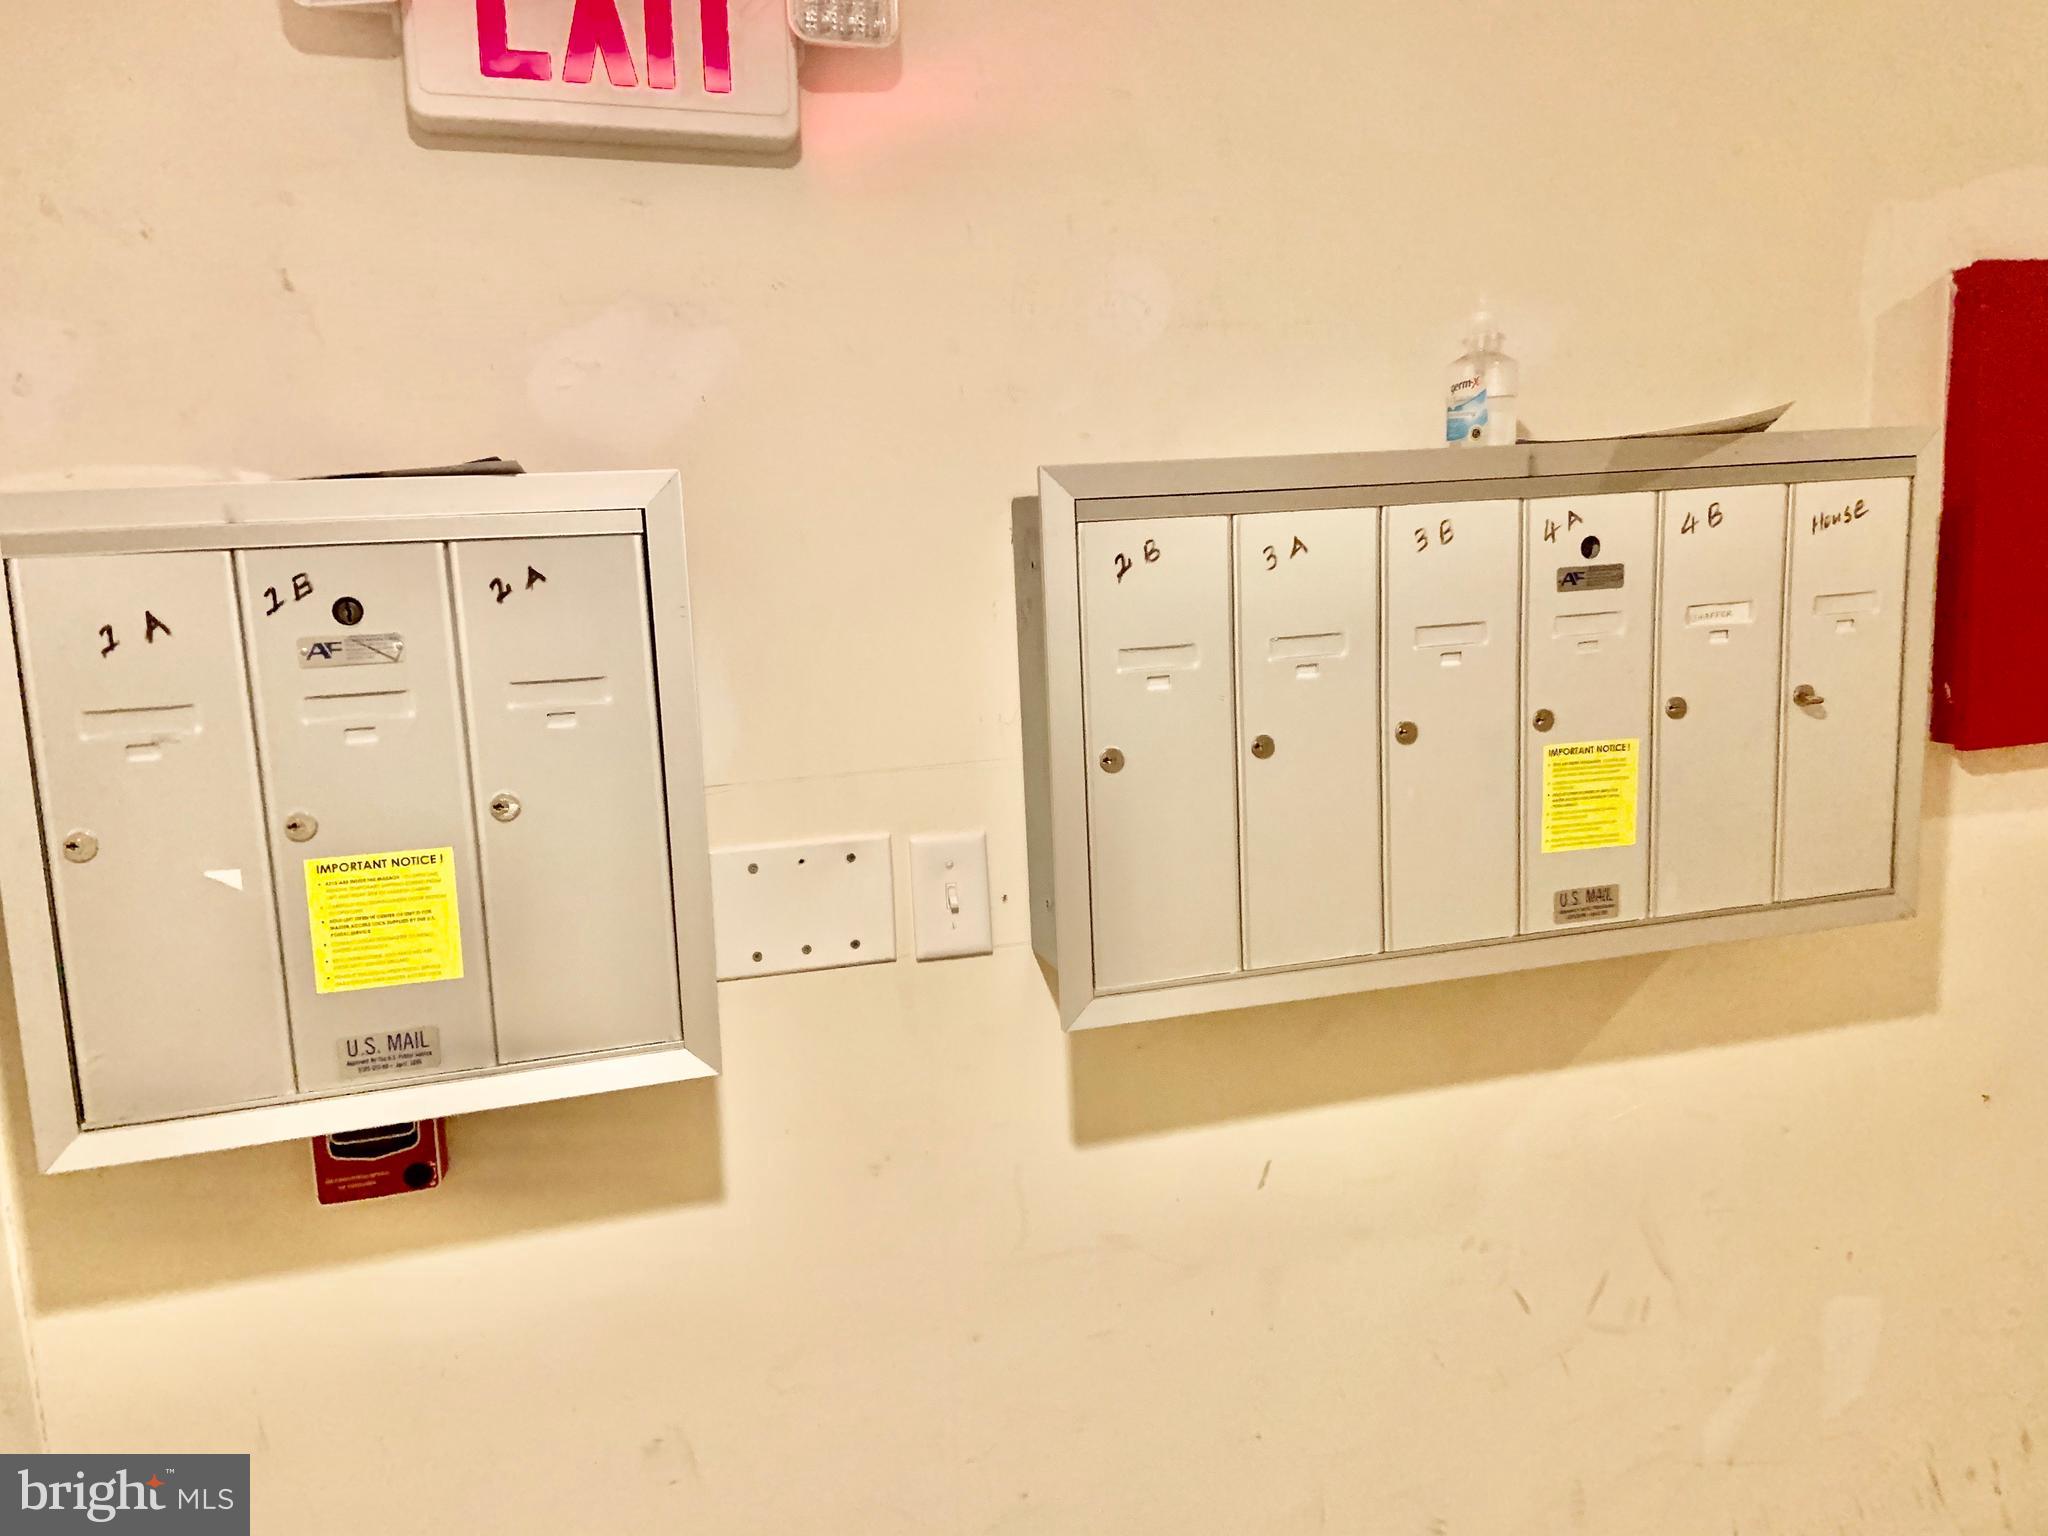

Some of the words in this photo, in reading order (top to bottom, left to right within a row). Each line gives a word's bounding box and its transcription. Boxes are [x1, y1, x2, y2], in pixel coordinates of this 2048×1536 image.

[1544, 519, 1561, 543] 4
[1567, 510, 1583, 531] A
[1681, 512, 1699, 534] 4
[1708, 502, 1723, 527] B
[1414, 527, 1428, 552] 3
[1440, 518, 1454, 545] B
[1114, 553, 1132, 580] 2
[1143, 539, 1160, 563] B
[1263, 545, 1277, 570] 3
[1290, 536, 1308, 559] A
[264, 586, 285, 616] 1
[292, 572, 313, 601] B
[489, 577, 513, 604] 2
[525, 565, 547, 591] A
[99, 624, 120, 658] 1
[145, 610, 172, 643] A
[306, 641, 343, 661] AF
[1549, 746, 1594, 757] IMPORTANT
[1597, 743, 1626, 753] NOTICE
[316, 859, 387, 874] IMPORTANT
[392, 854, 437, 867] NOTICE
[1586, 887, 1614, 903] MAIL
[346, 1036, 381, 1057] U.S.
[387, 1030, 430, 1052] MAIL
